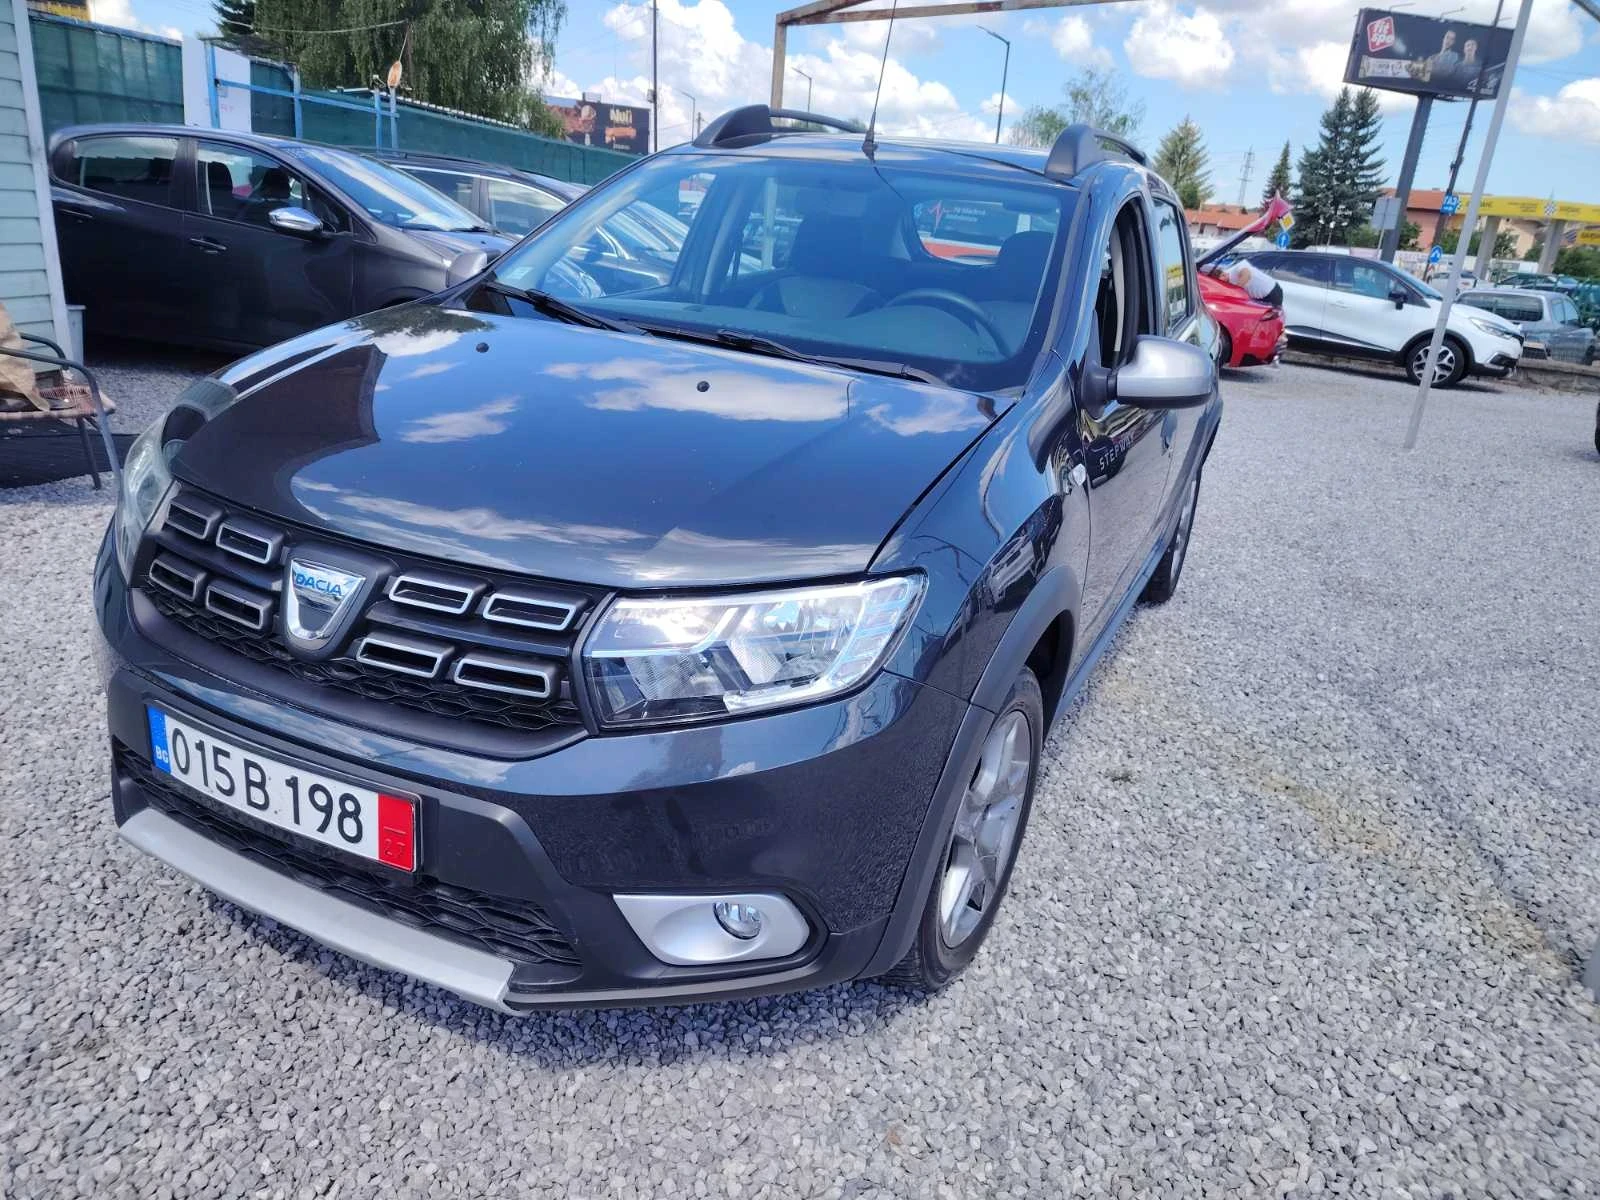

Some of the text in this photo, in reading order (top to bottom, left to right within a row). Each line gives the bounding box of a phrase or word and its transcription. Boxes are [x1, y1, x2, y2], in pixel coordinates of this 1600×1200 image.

[1098, 431, 1136, 472] STEPWAY
[294, 571, 343, 597] DACIA
[155, 745, 169, 763] BG
